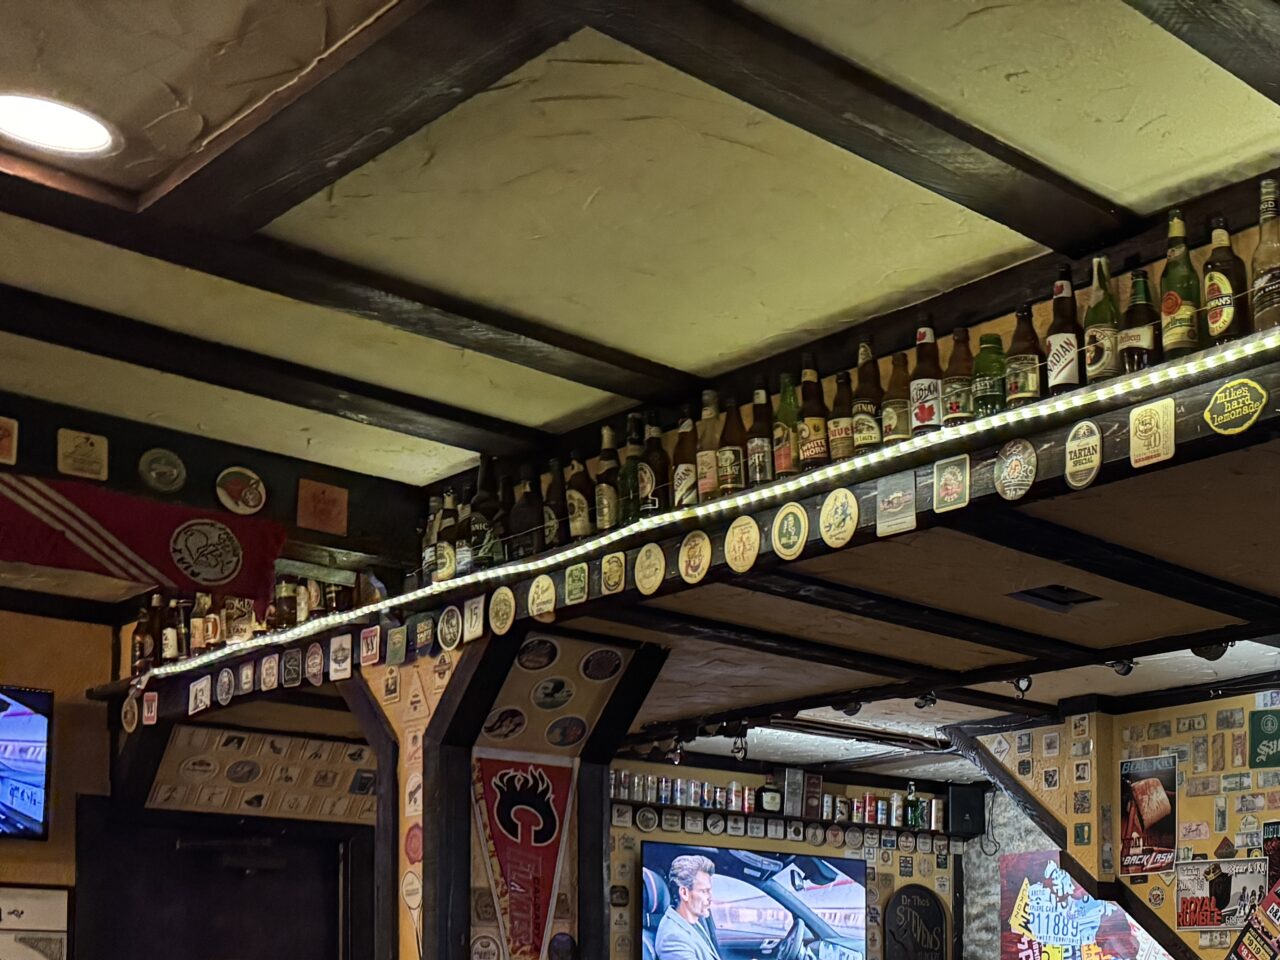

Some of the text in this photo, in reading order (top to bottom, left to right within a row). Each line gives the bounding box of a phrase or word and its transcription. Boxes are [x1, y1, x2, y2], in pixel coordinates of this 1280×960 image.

[1216, 386, 1249, 404] mike's
[1224, 395, 1250, 411] hard
[1212, 401, 1262, 426] lemonade
[1068, 444, 1098, 461] TARTAN
[1014, 883, 1029, 919] YUKON
[1180, 896, 1218, 911] ROYAL
[1178, 911, 1222, 927] RUMBLE
[896, 906, 941, 951] STEVENS
